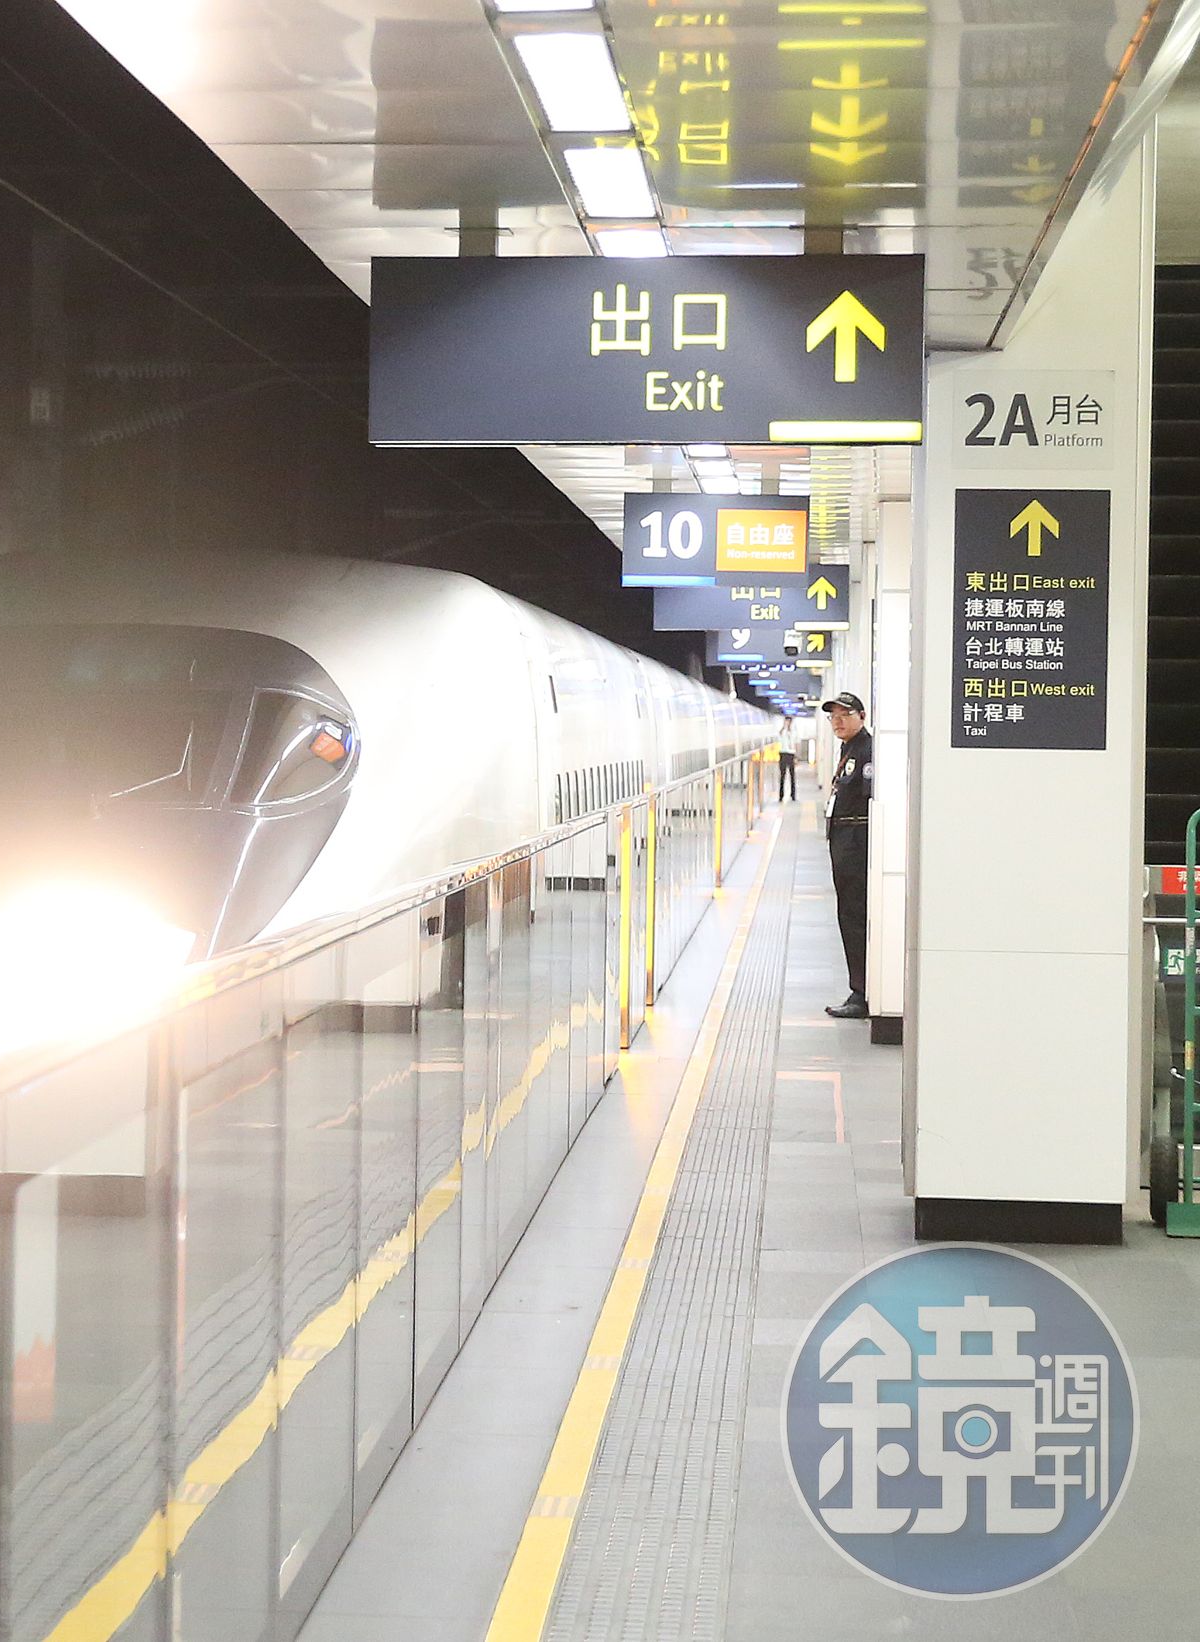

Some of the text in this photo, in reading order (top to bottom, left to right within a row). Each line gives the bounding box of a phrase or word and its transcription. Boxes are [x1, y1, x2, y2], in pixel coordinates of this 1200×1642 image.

[590, 283, 728, 357] 出口
[645, 369, 725, 411] Exit
[964, 393, 1039, 446] 2A
[1046, 394, 1103, 425] 月台
[1044, 433, 1103, 447] Platform
[640, 510, 703, 559] 10
[726, 523, 795, 546] 自由座
[726, 549, 795, 560] Non-reserved
[965, 571, 1096, 592] 東出口 East exit
[750, 604, 781, 620] Exit
[964, 598, 1066, 618] 捷運板南線
[966, 621, 1064, 632] MRT Bannan Line
[965, 637, 1065, 657] 台北轉運站
[966, 658, 1064, 671] Taipei Bus Station
[963, 677, 1095, 698] 西出口 West exit
[963, 702, 1025, 723] 計程車
[964, 725, 987, 736] Taxi
